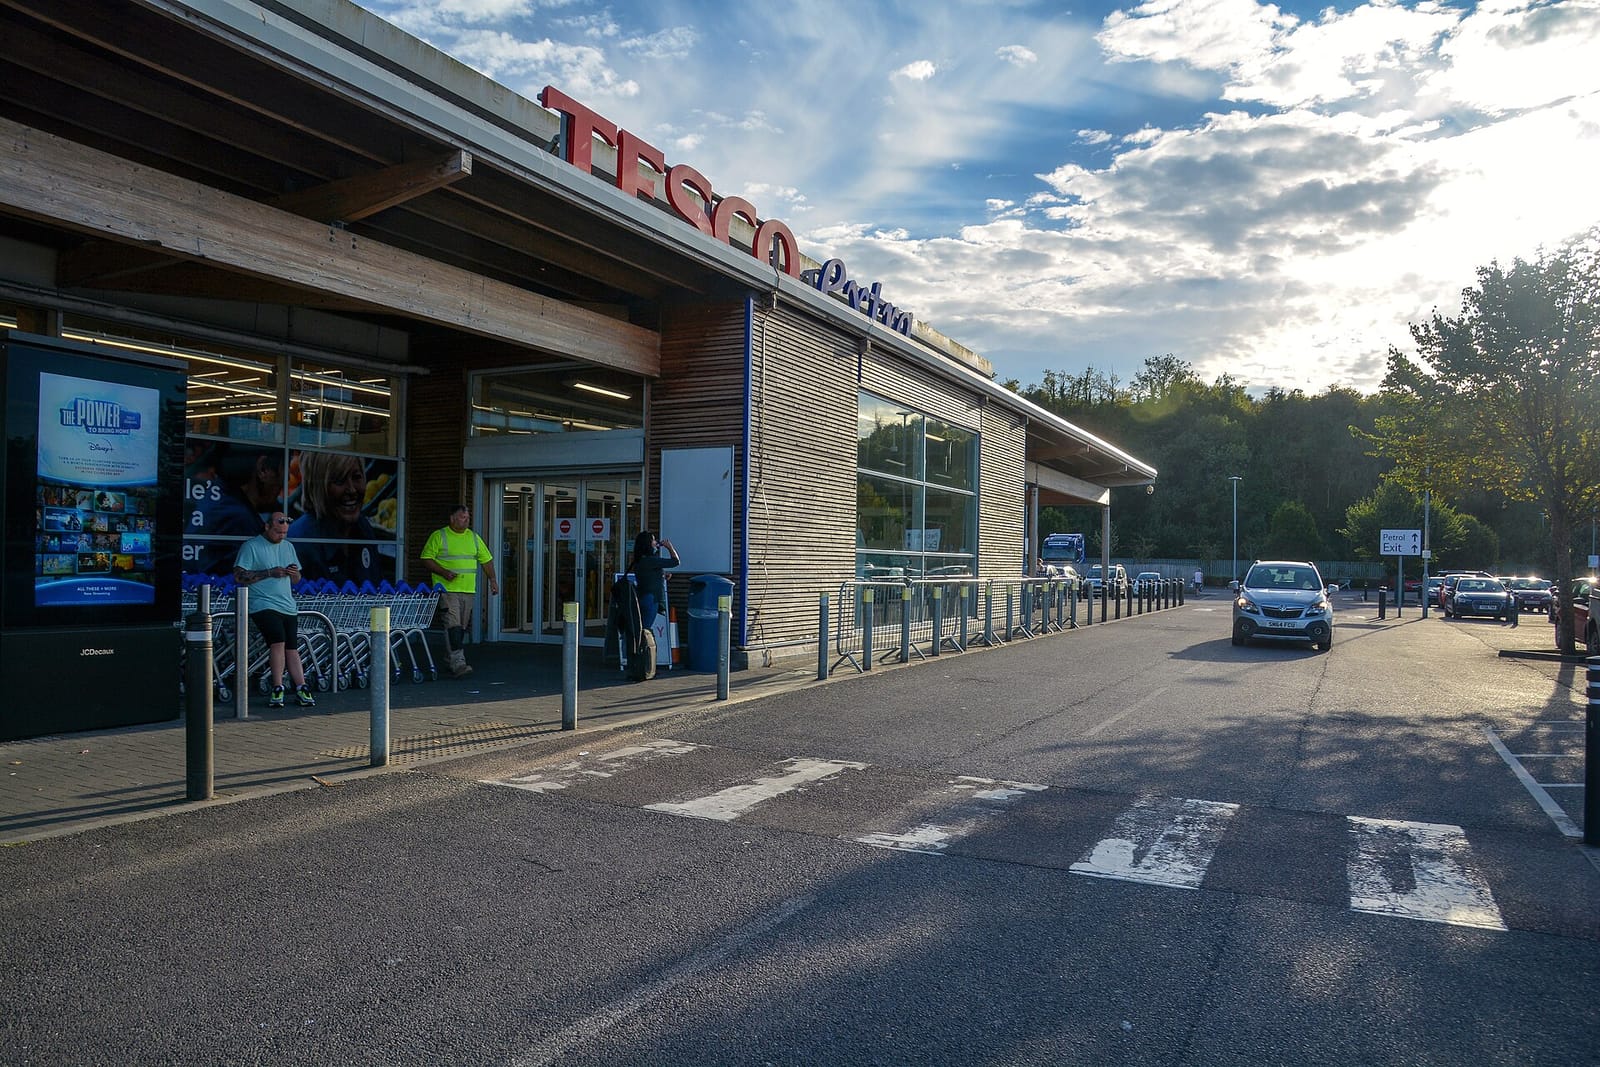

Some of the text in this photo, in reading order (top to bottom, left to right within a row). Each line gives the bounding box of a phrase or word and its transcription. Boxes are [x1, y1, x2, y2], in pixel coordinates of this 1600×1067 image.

[540, 85, 800, 279] TESCO
[62, 399, 120, 428] THE POWER
[1383, 533, 1406, 541] Petrol
[1384, 542, 1402, 552] Exit
